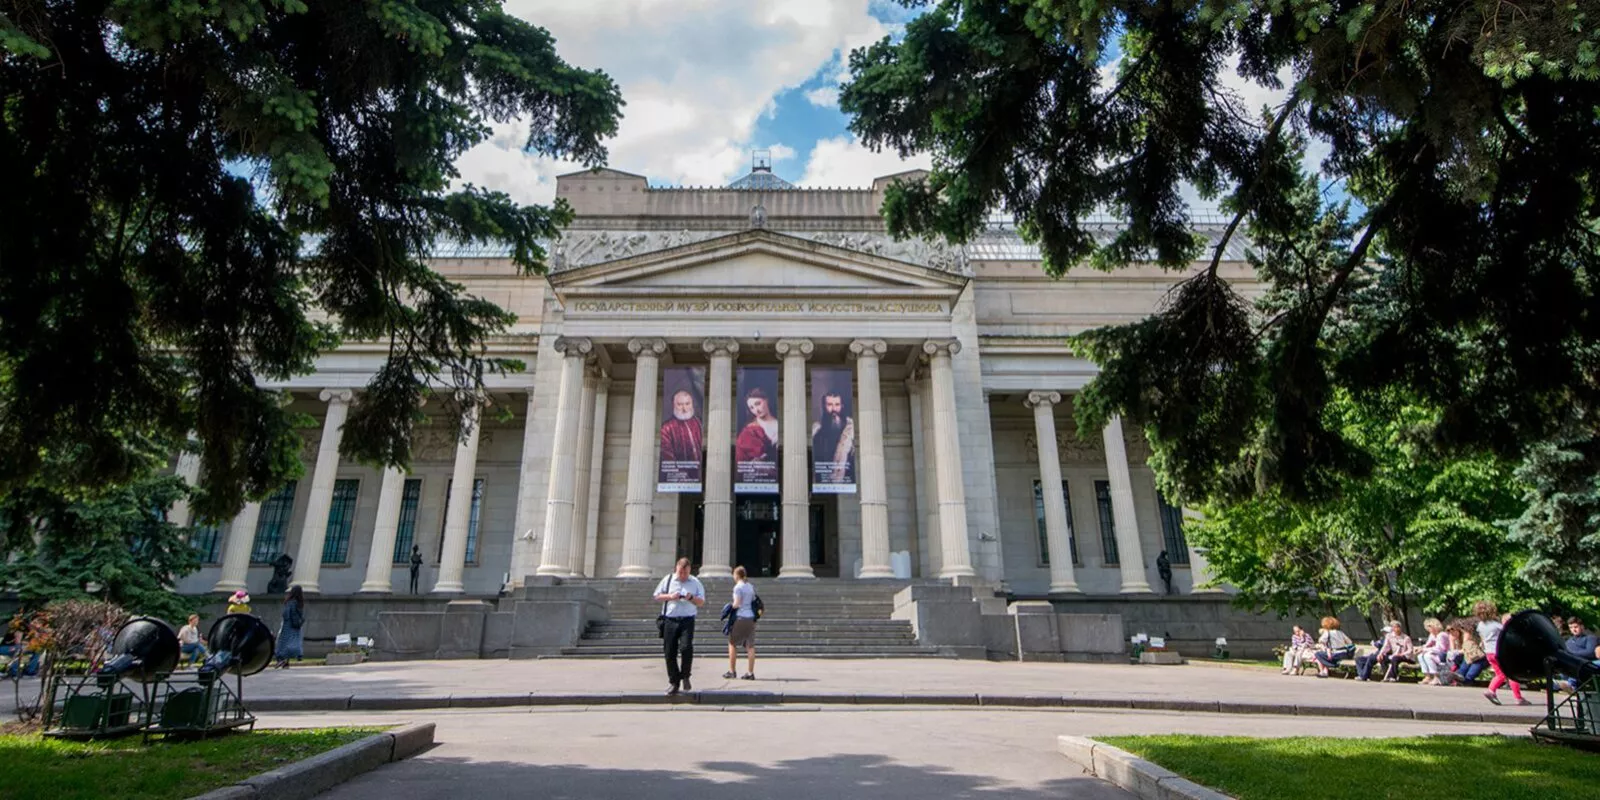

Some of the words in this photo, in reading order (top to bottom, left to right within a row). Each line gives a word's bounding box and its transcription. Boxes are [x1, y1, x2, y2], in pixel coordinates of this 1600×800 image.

[574, 301, 674, 312] ГОСУДАРСТВЕННЫЙ
[676, 300, 710, 312] МУЗЕЙ
[712, 302, 805, 312] ИЗОБРАЗИТЕЛЬНЫХ
[808, 302, 863, 313] ИСКУССТВ
